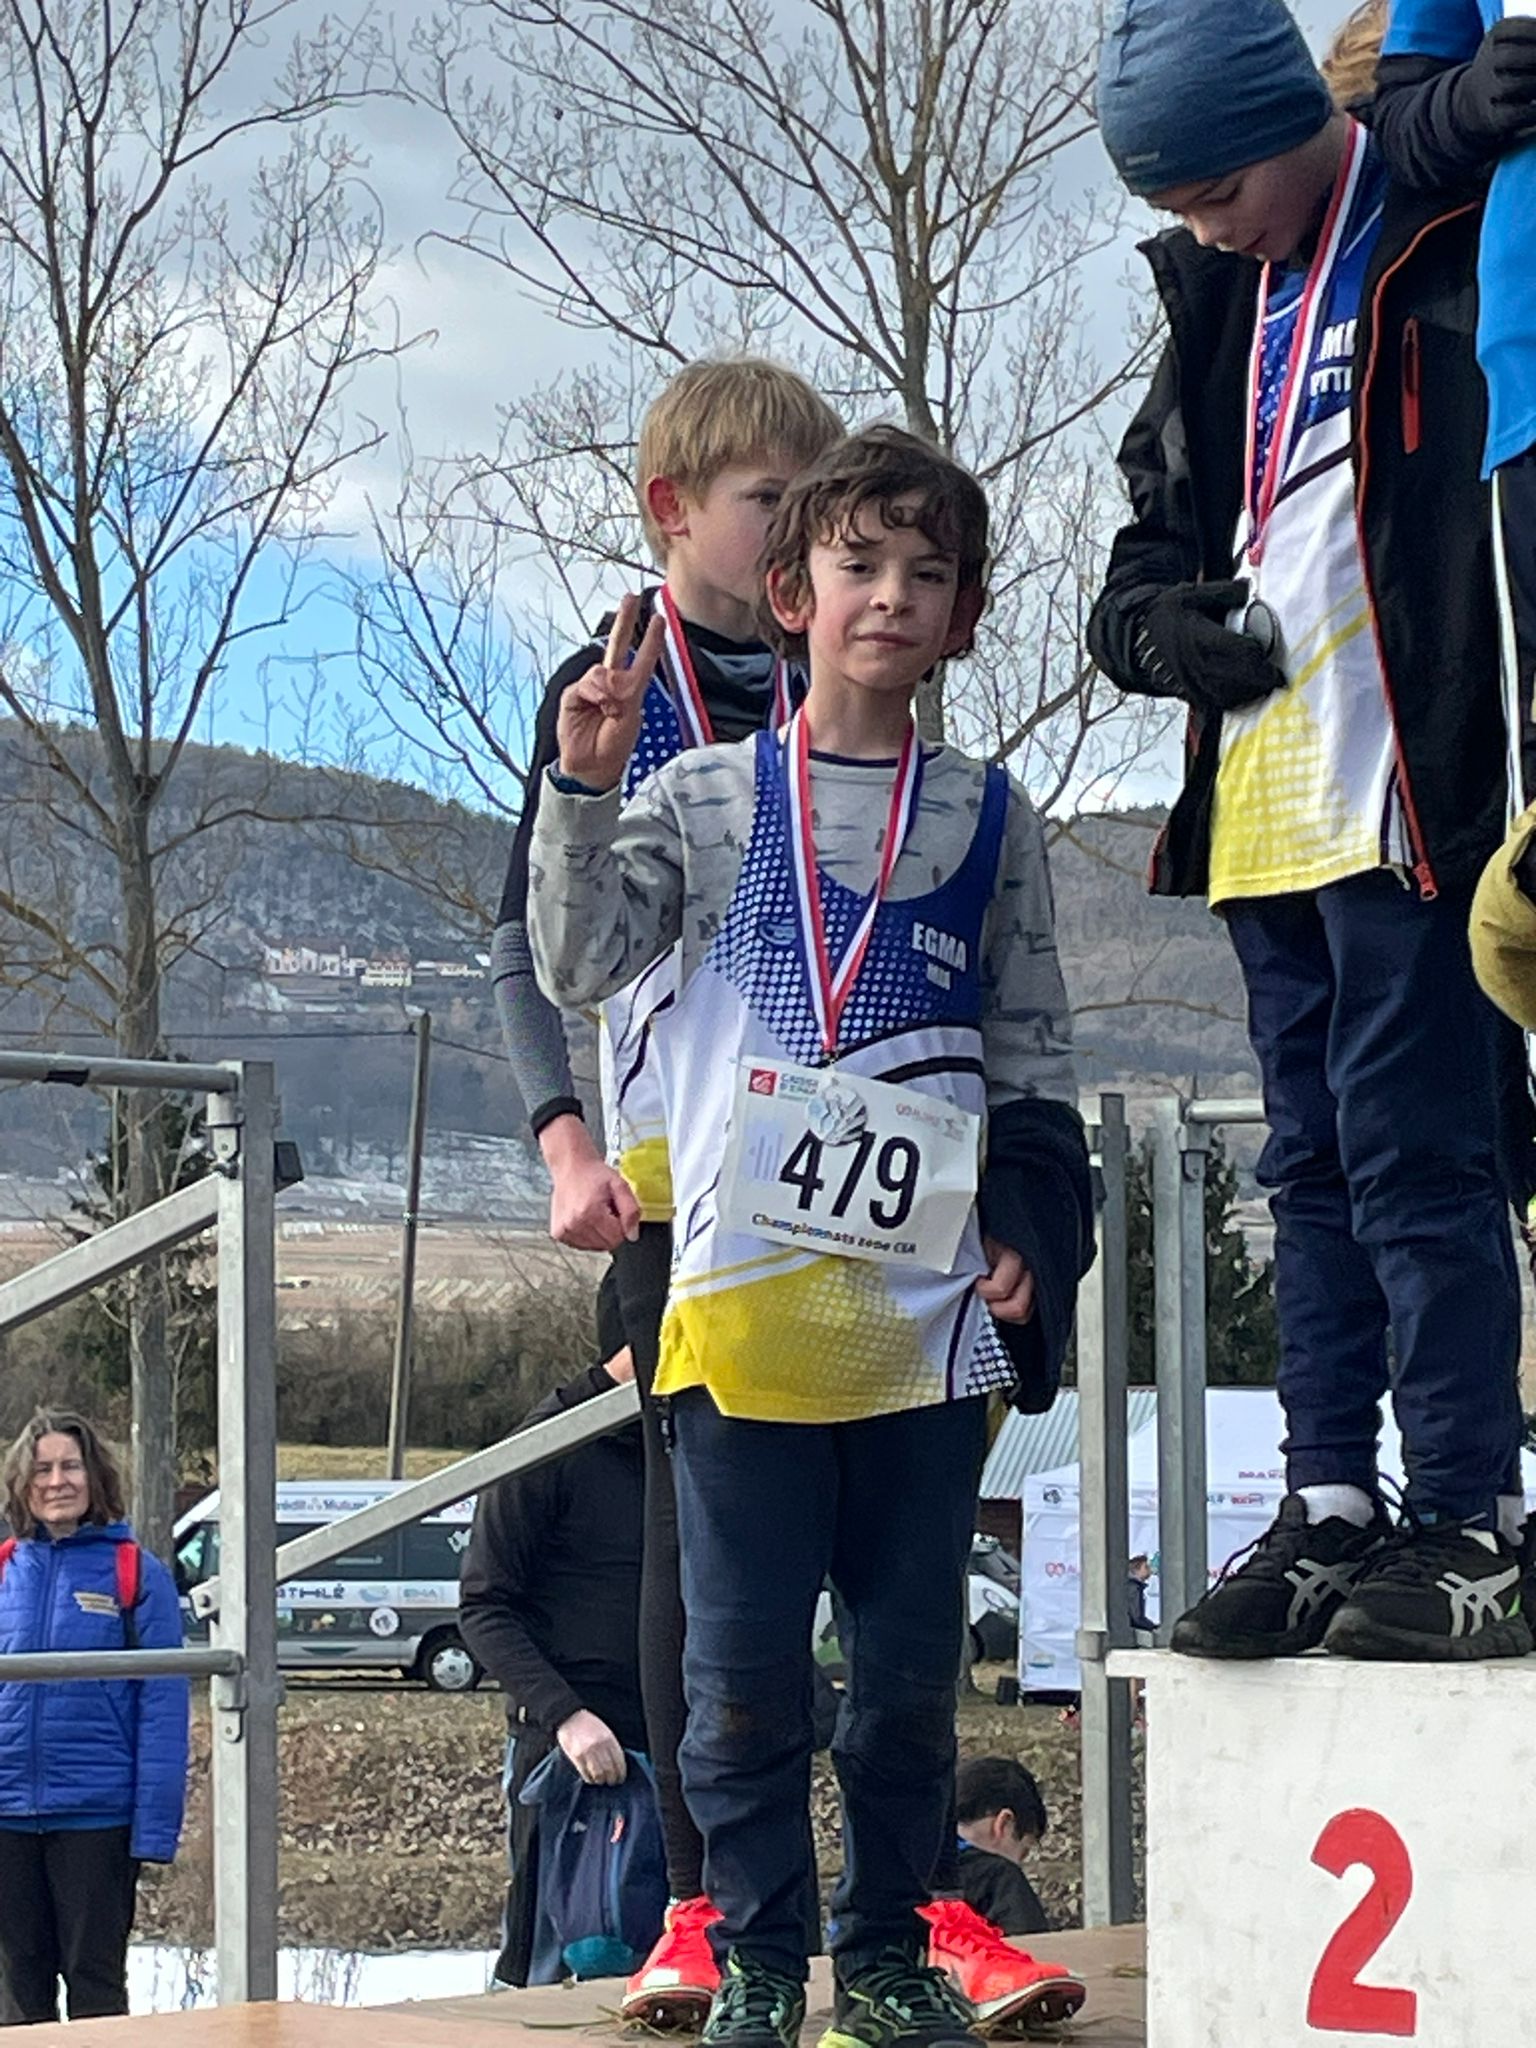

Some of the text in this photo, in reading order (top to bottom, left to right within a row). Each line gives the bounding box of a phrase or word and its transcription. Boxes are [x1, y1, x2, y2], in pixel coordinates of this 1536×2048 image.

[911, 921, 967, 972] EGMA
[778, 1128, 920, 1229] 479
[1306, 1807, 1416, 2038] 2
